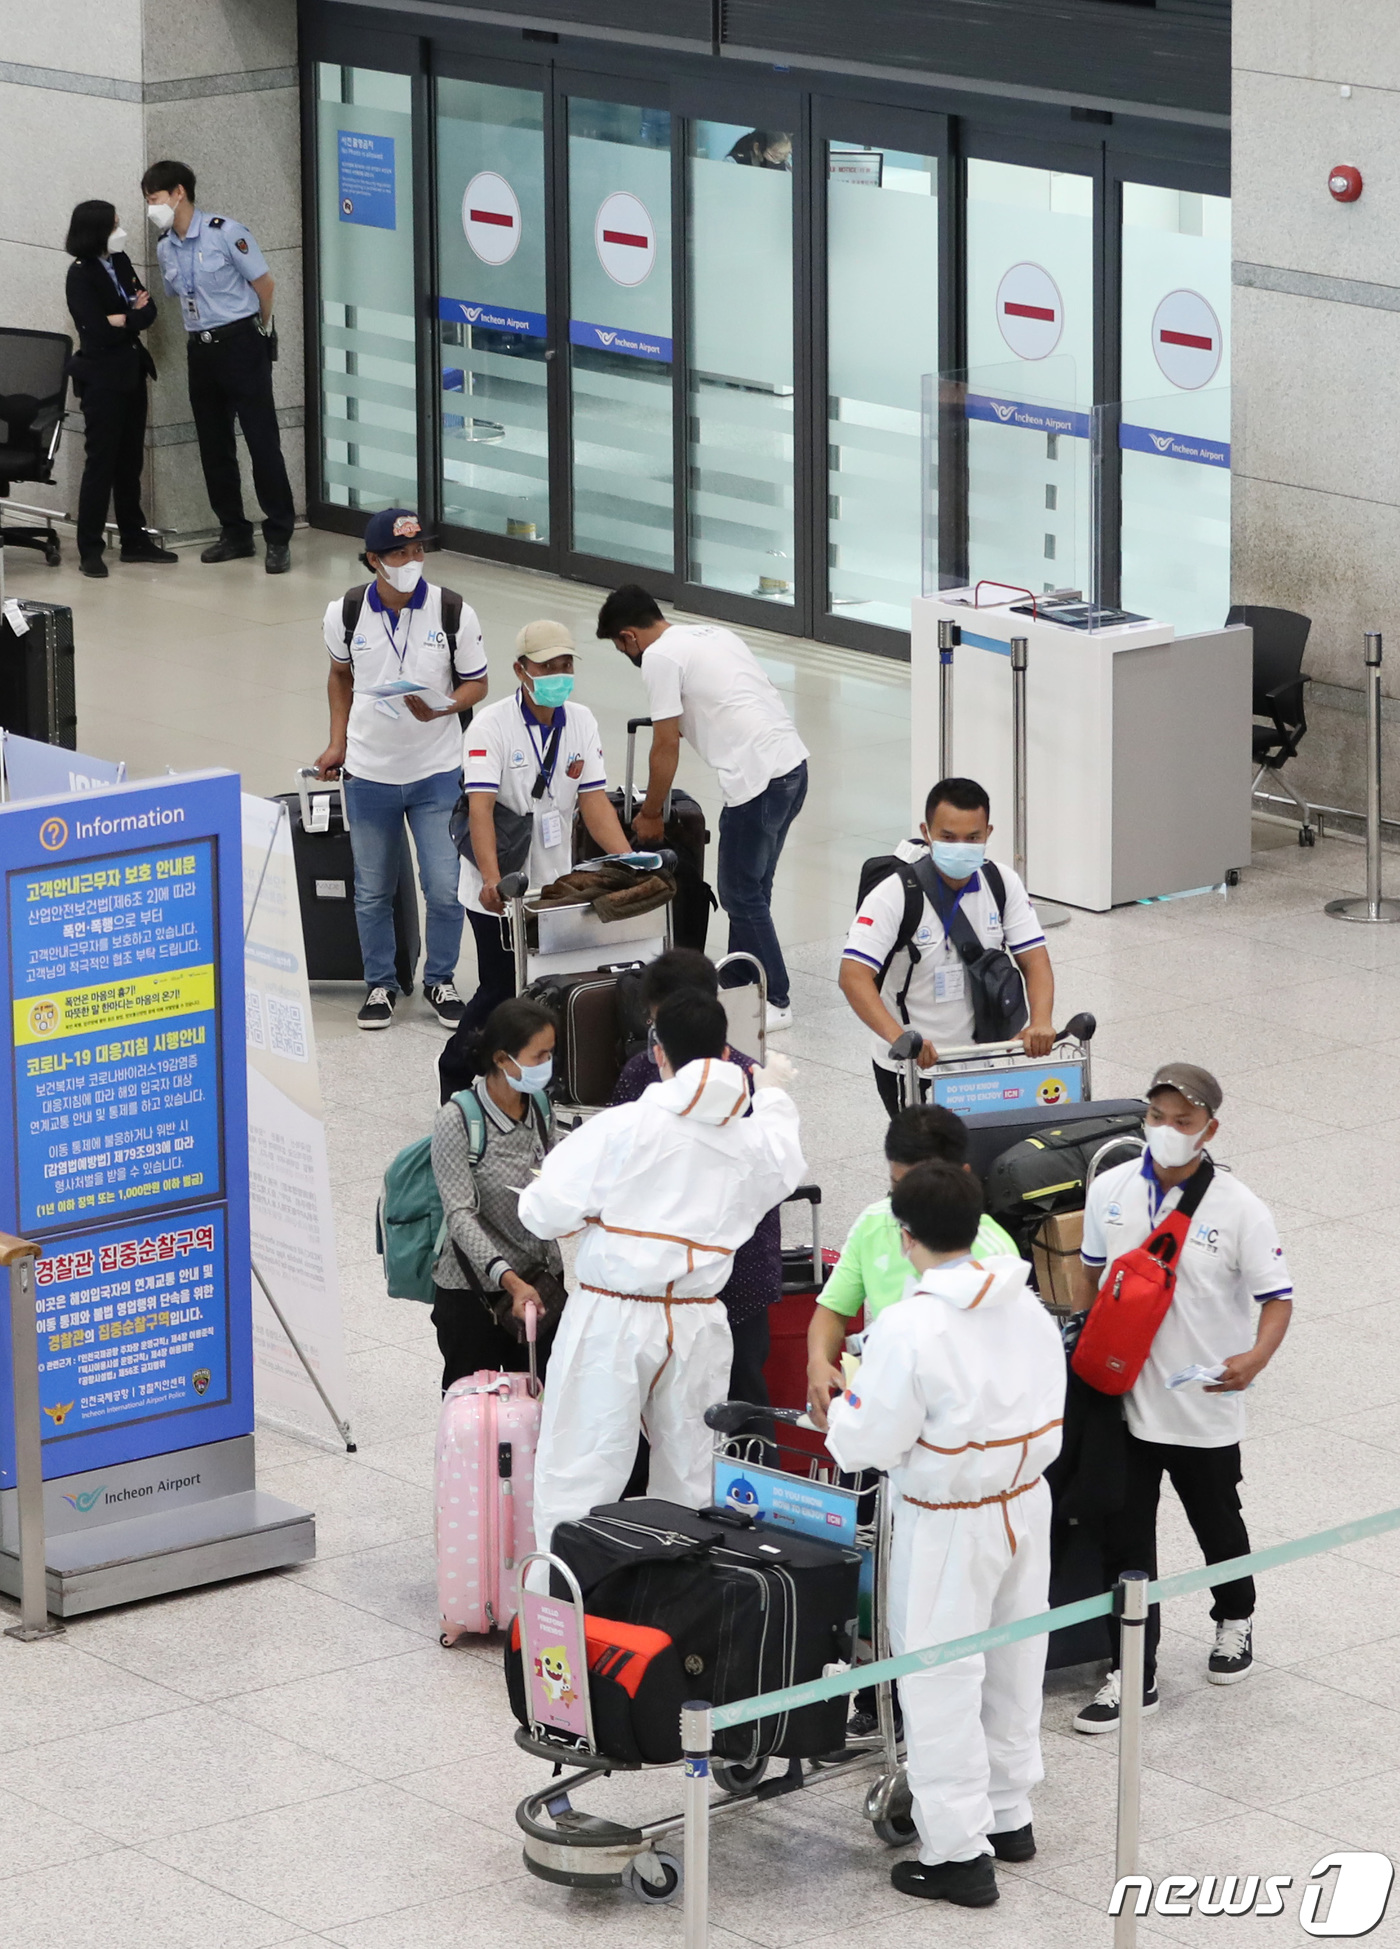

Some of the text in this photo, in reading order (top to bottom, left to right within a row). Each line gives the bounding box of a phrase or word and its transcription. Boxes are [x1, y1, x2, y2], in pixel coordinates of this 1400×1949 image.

[481, 313, 529, 330] Incheon Airport
[615, 337, 660, 354] Incheon Airport
[1015, 412, 1072, 430] Incheon Airport
[1172, 442, 1224, 461] Incheon Airport
[428, 630, 444, 643] HC
[76, 807, 185, 839] Information
[26, 855, 196, 902] 고객안내근무자 보호 안내문
[173, 882, 196, 899] 따라
[141, 908, 163, 924] 부터
[29, 922, 198, 964] 고객안내근무자를 보호하고 있습니다.
[26, 939, 201, 983] 고객님의 적극적인 협조 부탁 드립니다.
[65, 995, 89, 1008] 폭언은
[91, 989, 115, 1002] 마음의
[65, 1007, 89, 1020] 따뜻한
[91, 1004, 100, 1015] 말
[101, 997, 134, 1013] 한마디는
[135, 992, 160, 1006] 마음의
[27, 1026, 206, 1077] 코로나-19 대응지침 시행안내
[36, 1054, 198, 1098] 보건복지부 코로나바이러스19감염증
[947, 1082, 999, 1093] DO YOU KNOW
[42, 1073, 192, 1114] 대응지침에 따라 해외 입국자 대상
[947, 1095, 966, 1103] HOW
[978, 1092, 1001, 1100] ENJOY
[1004, 1090, 1018, 1098] ICN
[30, 1089, 206, 1135] 연계교통 안내 및 통제를 하고 있습니다.
[48, 1142, 68, 1158] 이동
[72, 1137, 101, 1155] 통제에
[156, 1122, 176, 1137] 위반
[179, 1119, 189, 1132] 시
[174, 1136, 194, 1151] 따라
[54, 1156, 184, 1194] 형사처벌을 받을 수 있습니다.
[57, 1198, 75, 1212] 이하
[98, 1192, 115, 1205] 또는
[118, 1181, 160, 1202] 1,000만원
[163, 1177, 180, 1191] 이하
[1196, 1224, 1218, 1243] HC
[35, 1250, 94, 1286] 경찰관
[100, 1225, 214, 1273] 집중순찰구역
[35, 1264, 213, 1314] 이곳은 해외입국자의 연계교통 안내 및
[36, 1284, 214, 1334] 이동 통제와 불법 영업행위 단속을 위한
[48, 1306, 203, 1350] 경찰관의 집중순찰구역입니다.
[81, 1376, 186, 1409] 인천국제공항 경찰치안센터
[81, 1391, 186, 1419] Incheon International Airport Police
[105, 1473, 200, 1505] Incheon Airport
[791, 1506, 800, 1514] TO
[827, 1514, 840, 1525] ICN
[541, 1606, 559, 1616] HELLO
